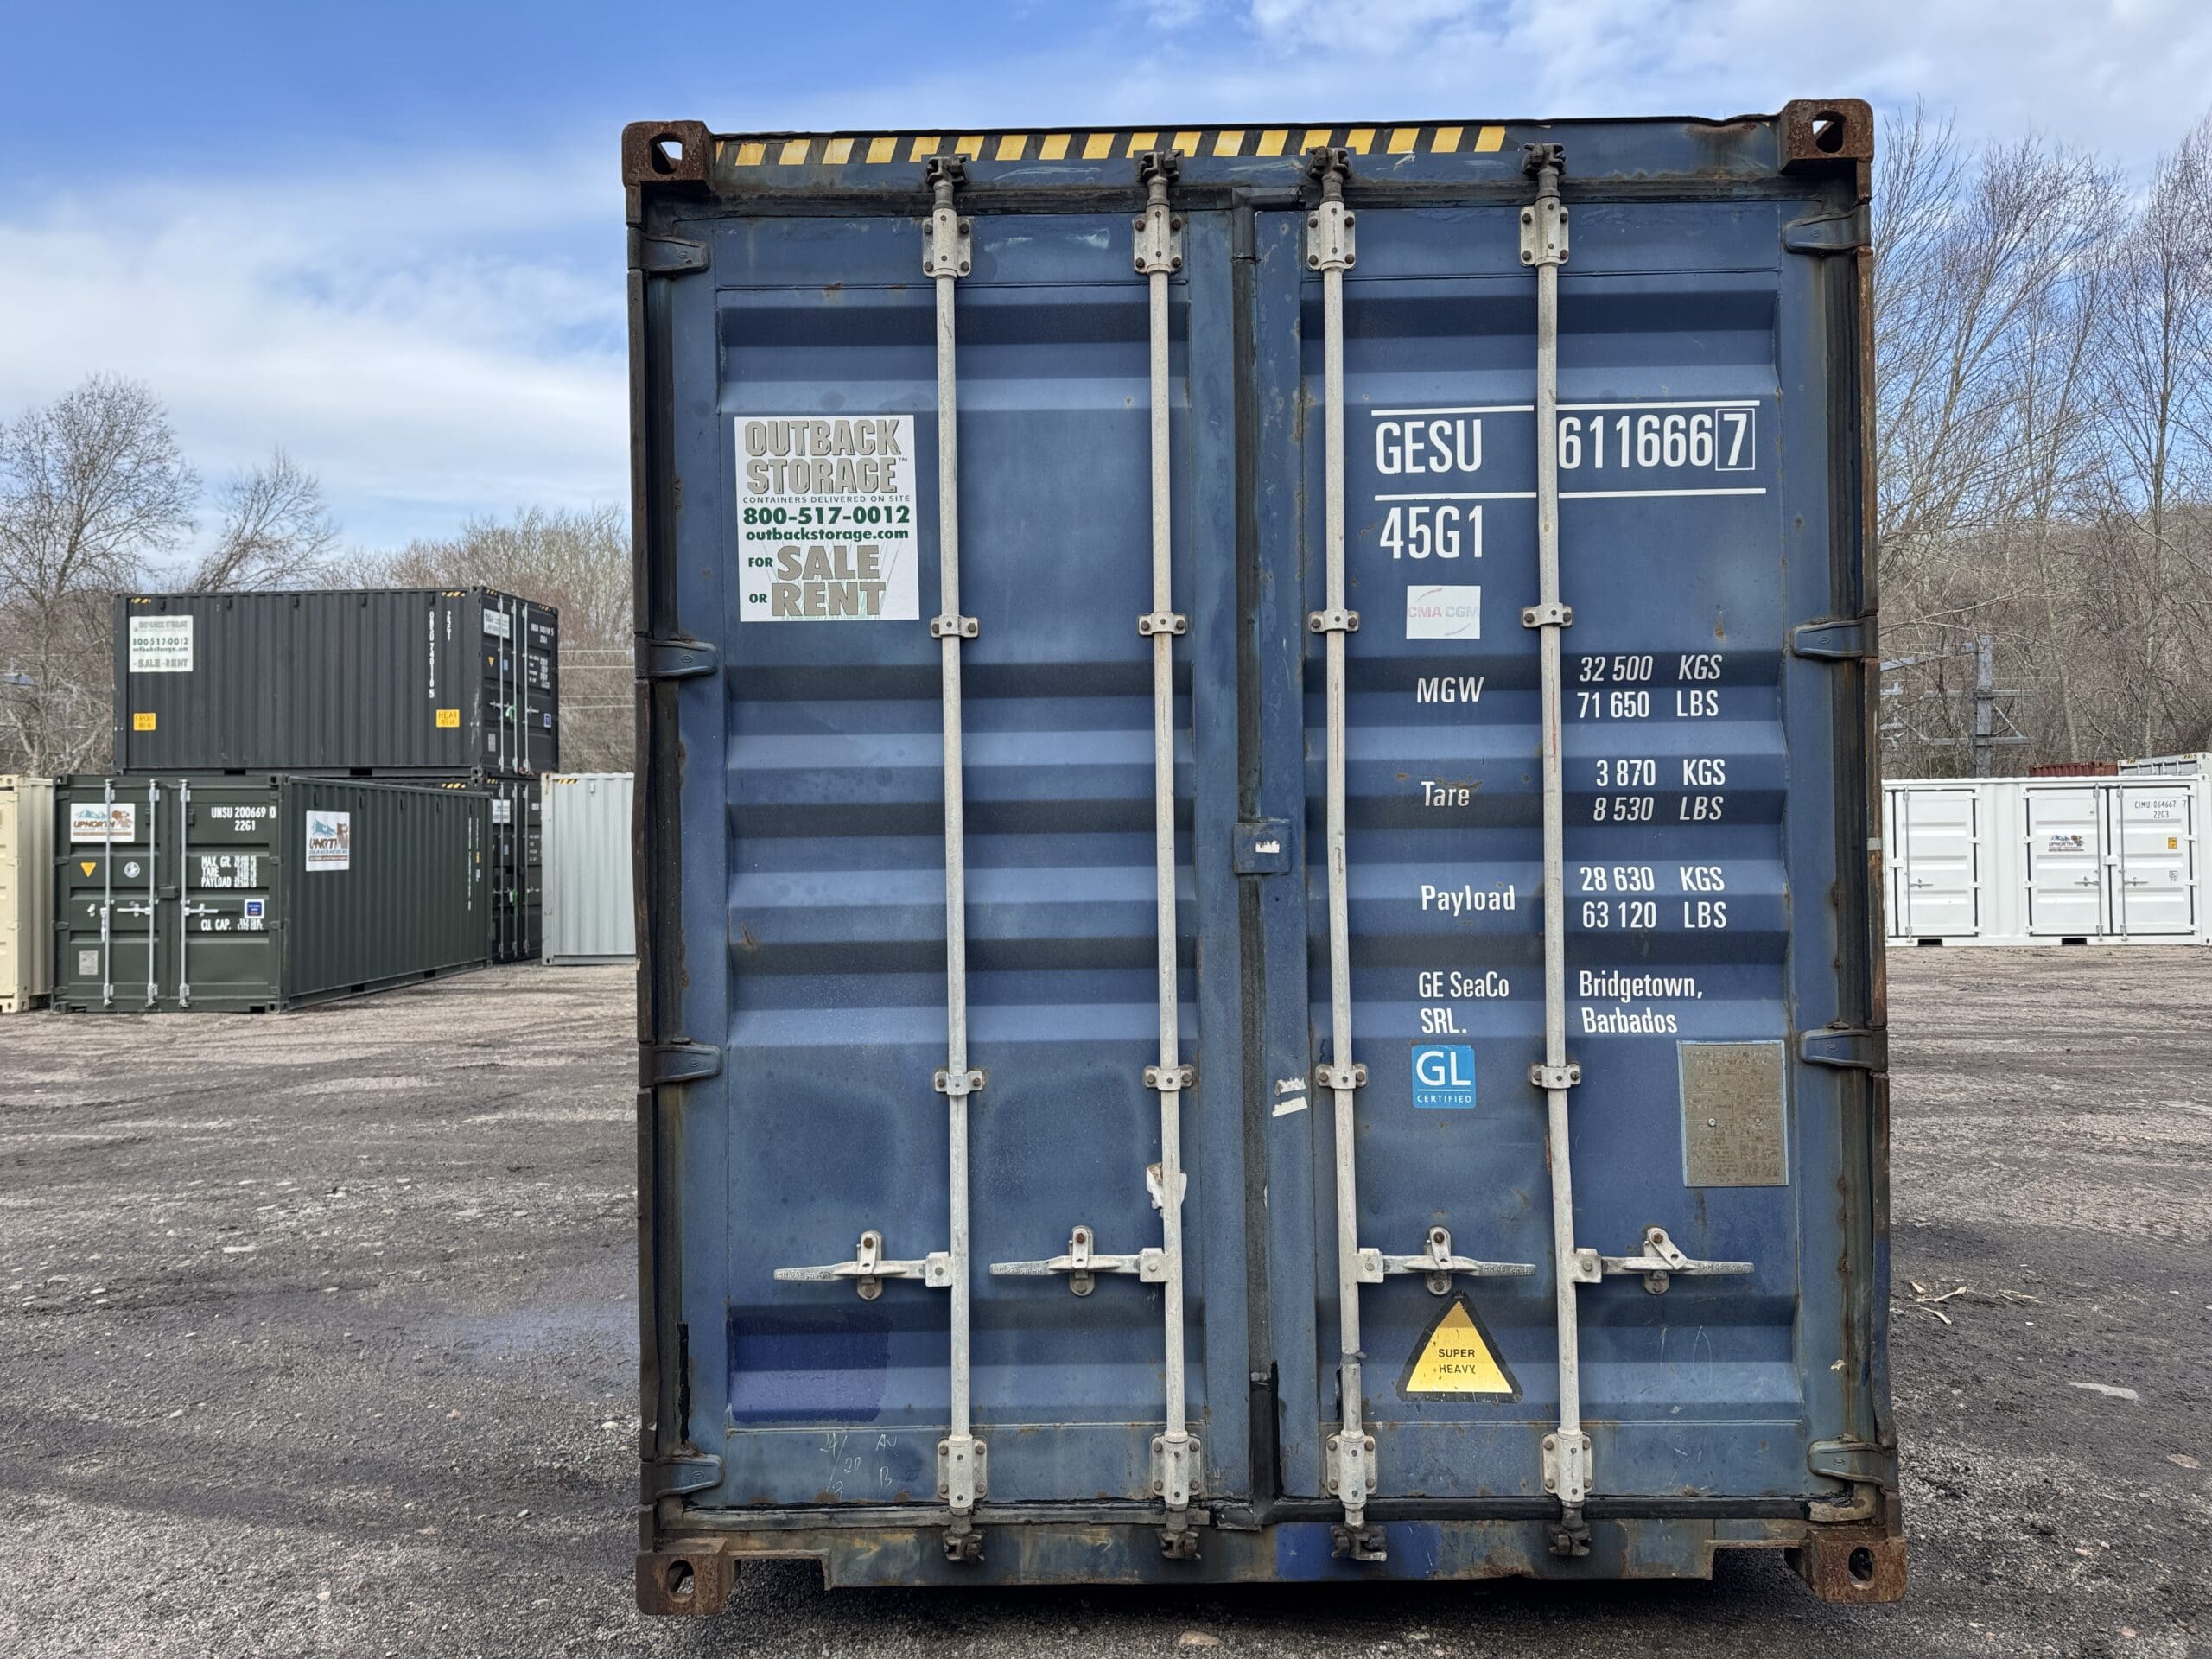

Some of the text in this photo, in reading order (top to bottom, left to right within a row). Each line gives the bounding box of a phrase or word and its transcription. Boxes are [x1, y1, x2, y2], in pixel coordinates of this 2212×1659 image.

[745, 419, 902, 456] OUTBACK
[1376, 419, 1482, 474] GESU
[747, 457, 897, 494] STORAGE
[743, 505, 910, 524] 800-517-0012
[746, 527, 909, 542] outbackstorage.com
[1380, 505, 1483, 559] 45G1
[748, 545, 880, 581] FOR SALE
[749, 582, 886, 617] OR RENT
[1408, 606, 1442, 618] CMA
[1579, 654, 1722, 682] 32 500 KGS
[1417, 677, 1484, 703] MGW
[1577, 690, 1719, 718] 71 650 LBS
[1596, 759, 1726, 786] 3 870 KGS
[1421, 781, 1470, 807] Tare
[211, 807, 232, 818] UNSU
[235, 806, 266, 818] 200669
[1593, 796, 1723, 821] 8 530 LBS
[235, 820, 256, 831] 22G1
[201, 877, 232, 887] PAYLOAD
[1580, 866, 1725, 891] 28 630 KGS
[1421, 885, 1516, 917] Payload
[1582, 901, 1726, 929] 63 120 LBS
[1419, 971, 1510, 998] GE SeaCo
[1579, 970, 1702, 1003] Bridgetown,
[1421, 1008, 1466, 1034] SRL.
[1581, 1007, 1677, 1033] Barbados
[1416, 1050, 1471, 1086] GL
[1417, 1095, 1471, 1103] CERTIFIED
[1438, 1349, 1475, 1357] SUPER
[1439, 1364, 1476, 1374] HEAVY
